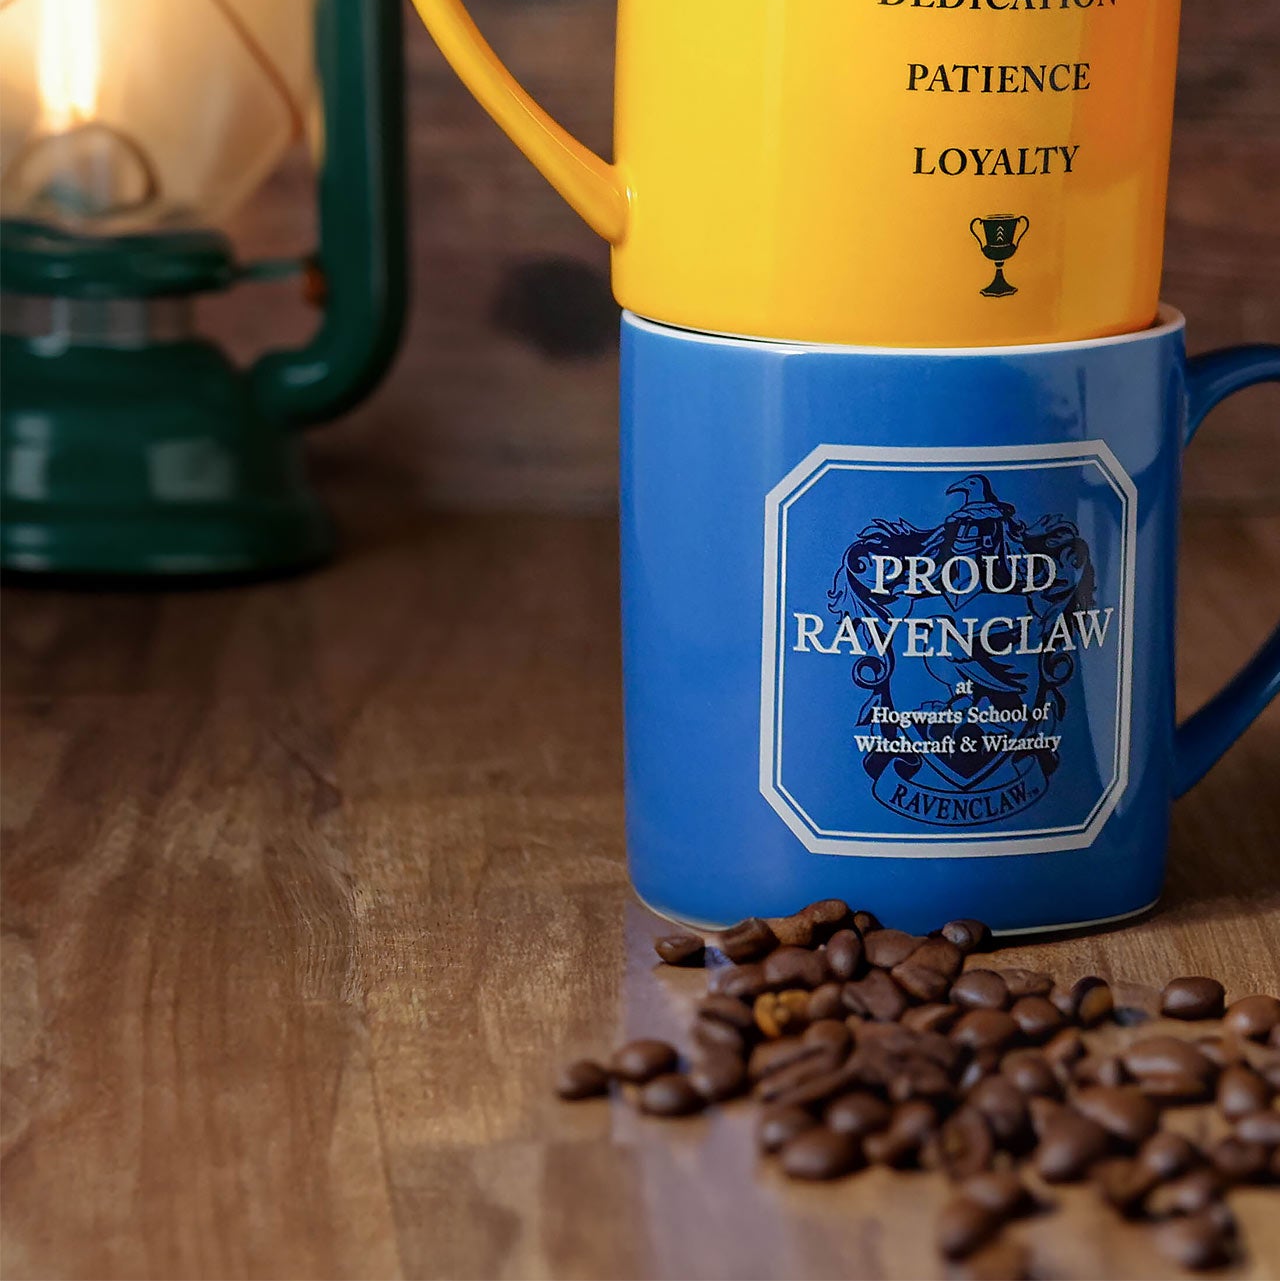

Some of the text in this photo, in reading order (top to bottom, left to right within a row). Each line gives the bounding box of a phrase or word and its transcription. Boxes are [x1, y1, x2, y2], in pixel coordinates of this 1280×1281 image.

[905, 63, 1091, 94] PATIENCE
[912, 145, 1080, 176] LOYALTY
[870, 554, 1057, 594] PROUD
[792, 607, 1114, 657] RAVENCLAW
[955, 679, 974, 695] at
[871, 702, 1051, 728] Hogwarts School of
[854, 732, 1062, 754] Witchcraft & Wizardry
